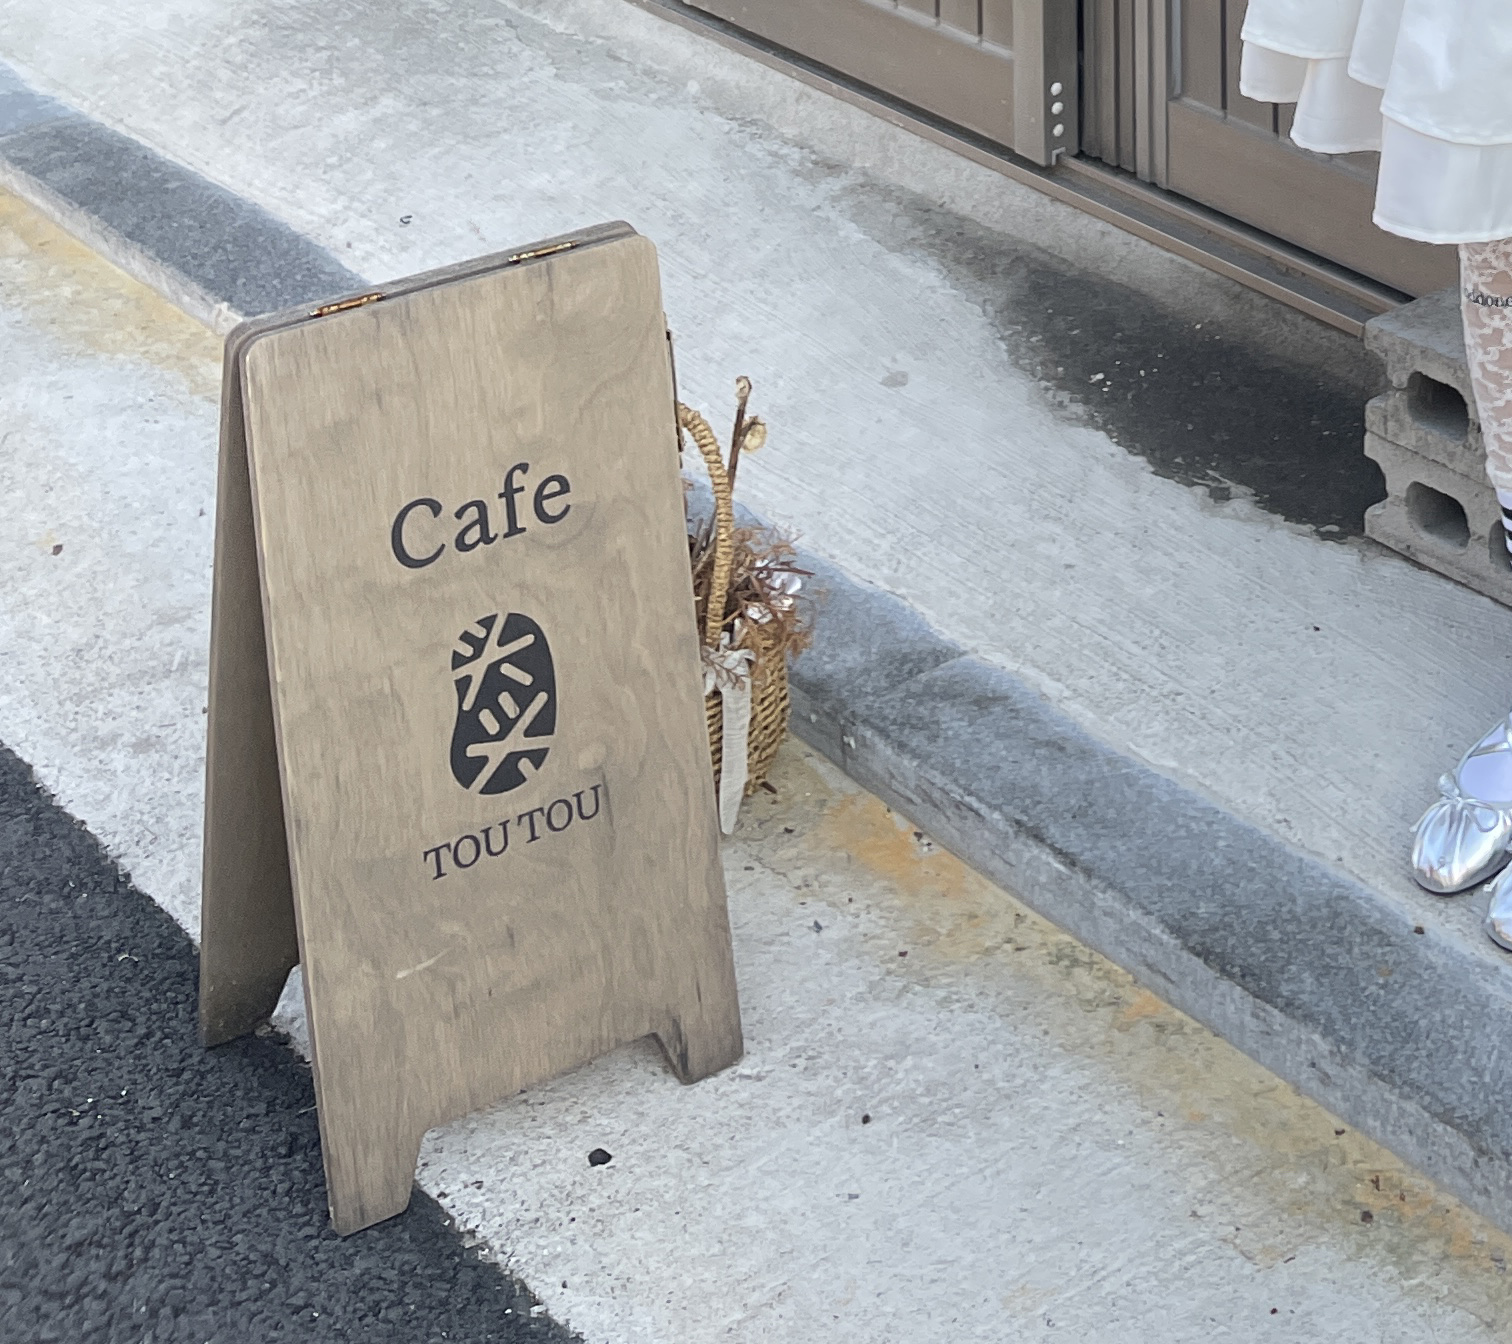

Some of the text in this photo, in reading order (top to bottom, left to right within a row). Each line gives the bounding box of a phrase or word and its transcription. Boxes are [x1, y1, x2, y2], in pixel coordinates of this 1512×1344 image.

[391, 461, 572, 569] Cafe
[422, 783, 603, 881] TOU TOU
